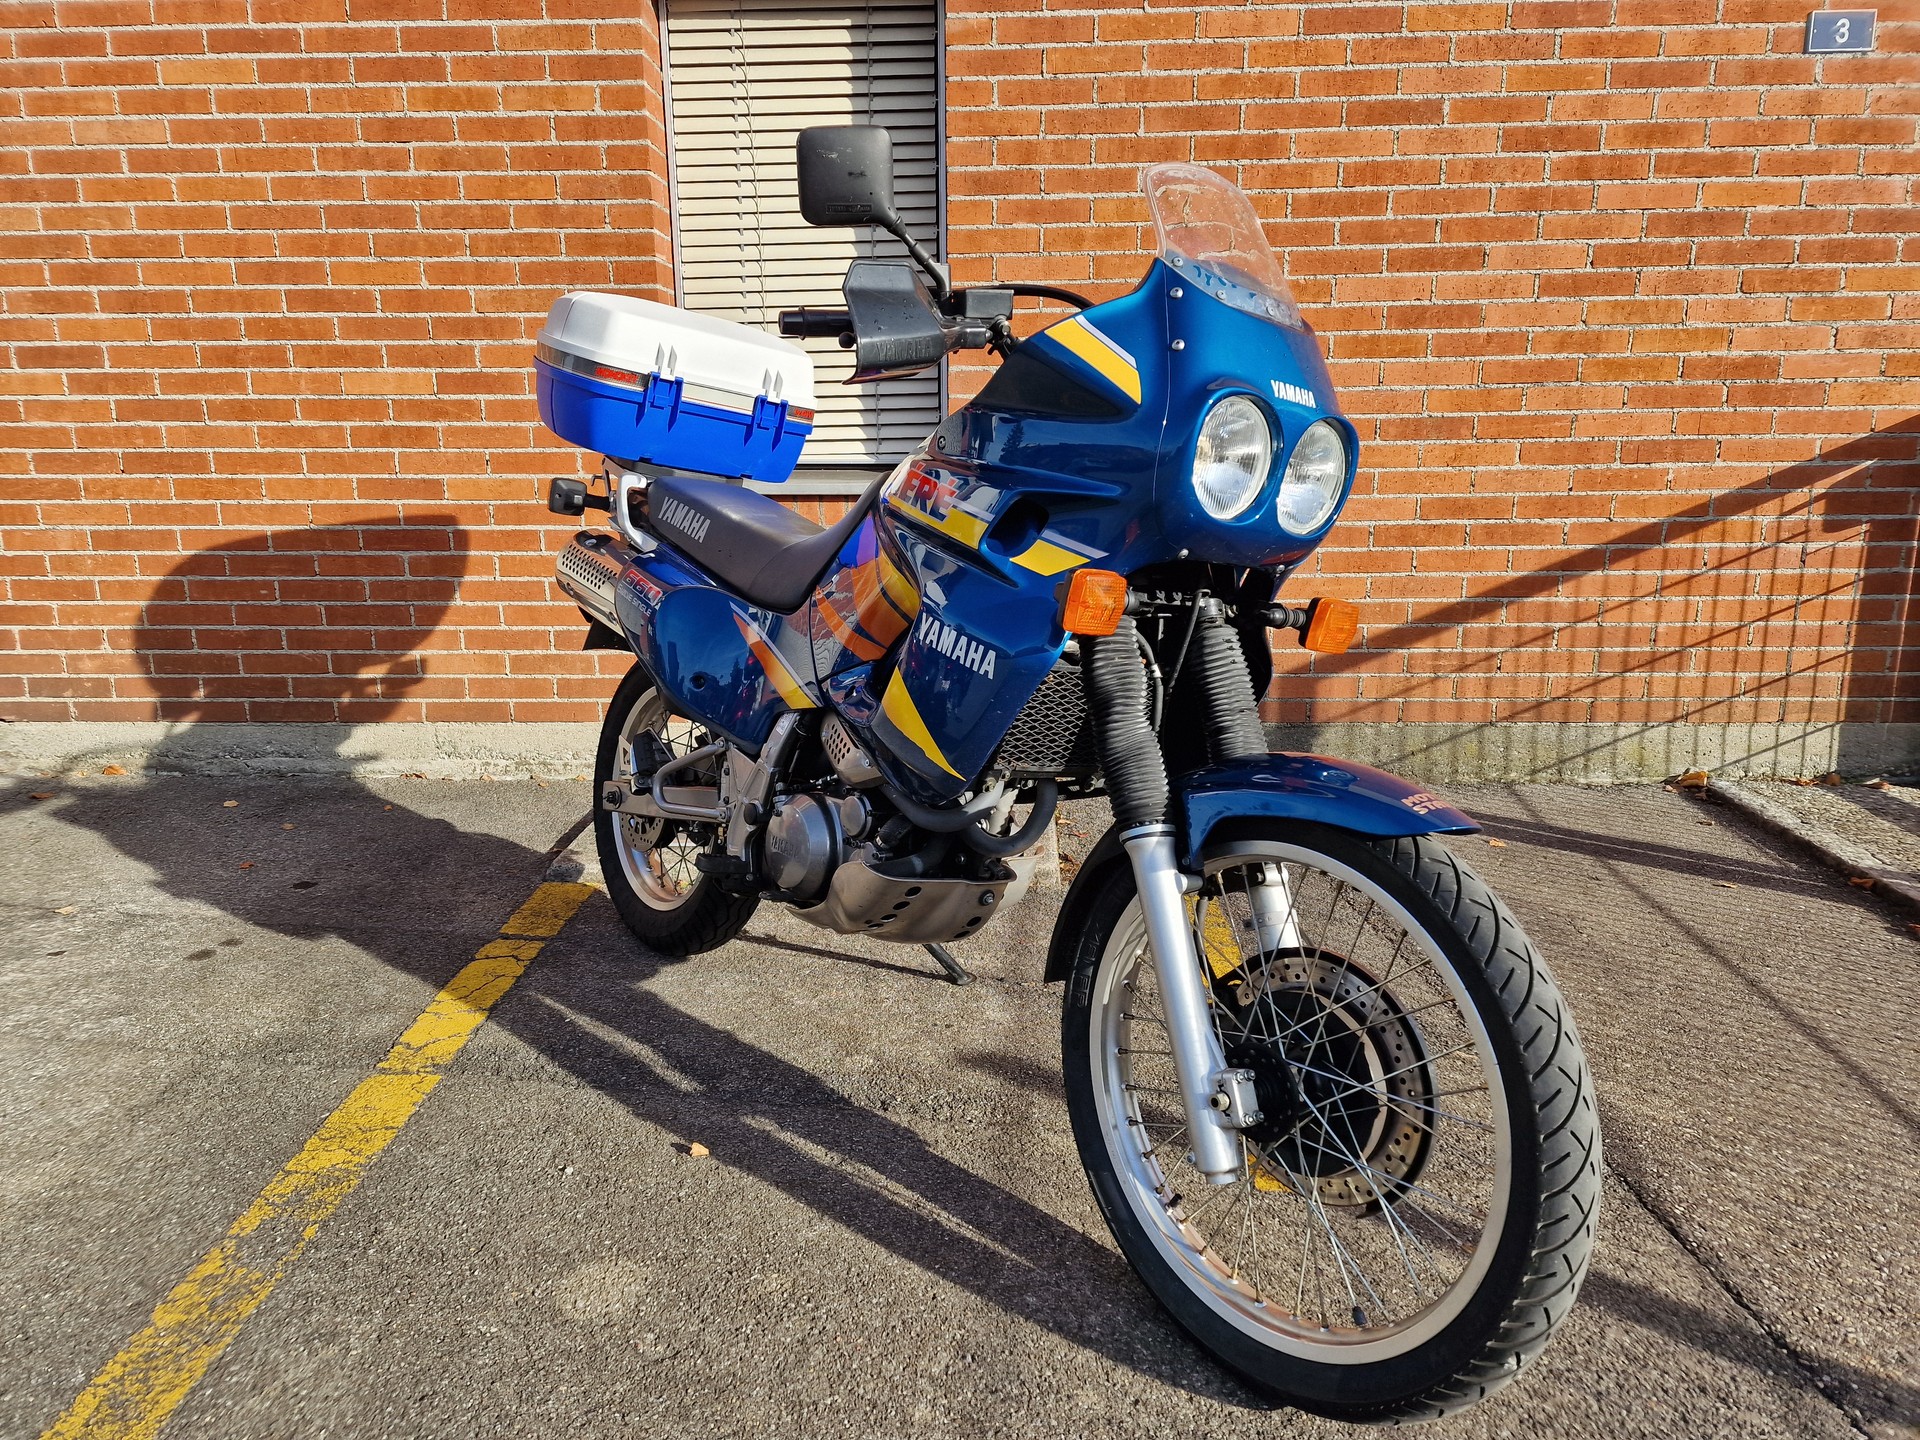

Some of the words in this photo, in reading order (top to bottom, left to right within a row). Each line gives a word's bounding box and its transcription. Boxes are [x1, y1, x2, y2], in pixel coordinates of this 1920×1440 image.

[1835, 18, 1850, 43] 3
[876, 337, 932, 361] YAMAHA
[1271, 380, 1316, 408] YAMAHA
[658, 496, 710, 543] YAMAHA
[622, 569, 663, 605] 660
[632, 597, 652, 616] SINGLE
[918, 613, 996, 680] YAMAHA
